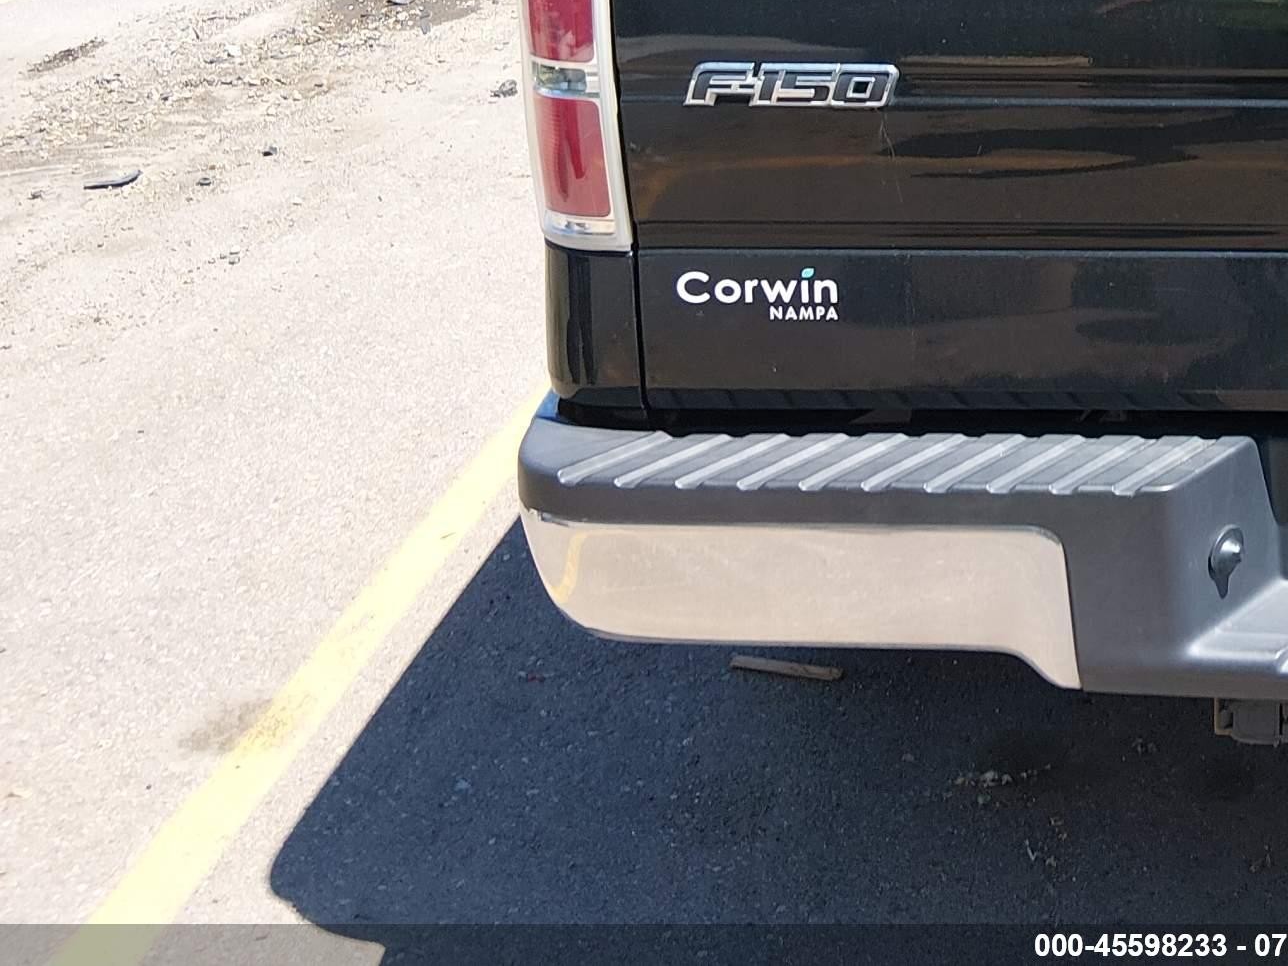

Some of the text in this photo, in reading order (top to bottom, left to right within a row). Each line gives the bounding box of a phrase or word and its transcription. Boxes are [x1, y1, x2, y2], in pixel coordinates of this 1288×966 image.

[683, 62, 901, 108] F-150
[675, 267, 839, 304] Corwin
[769, 305, 839, 321] NAMPA
